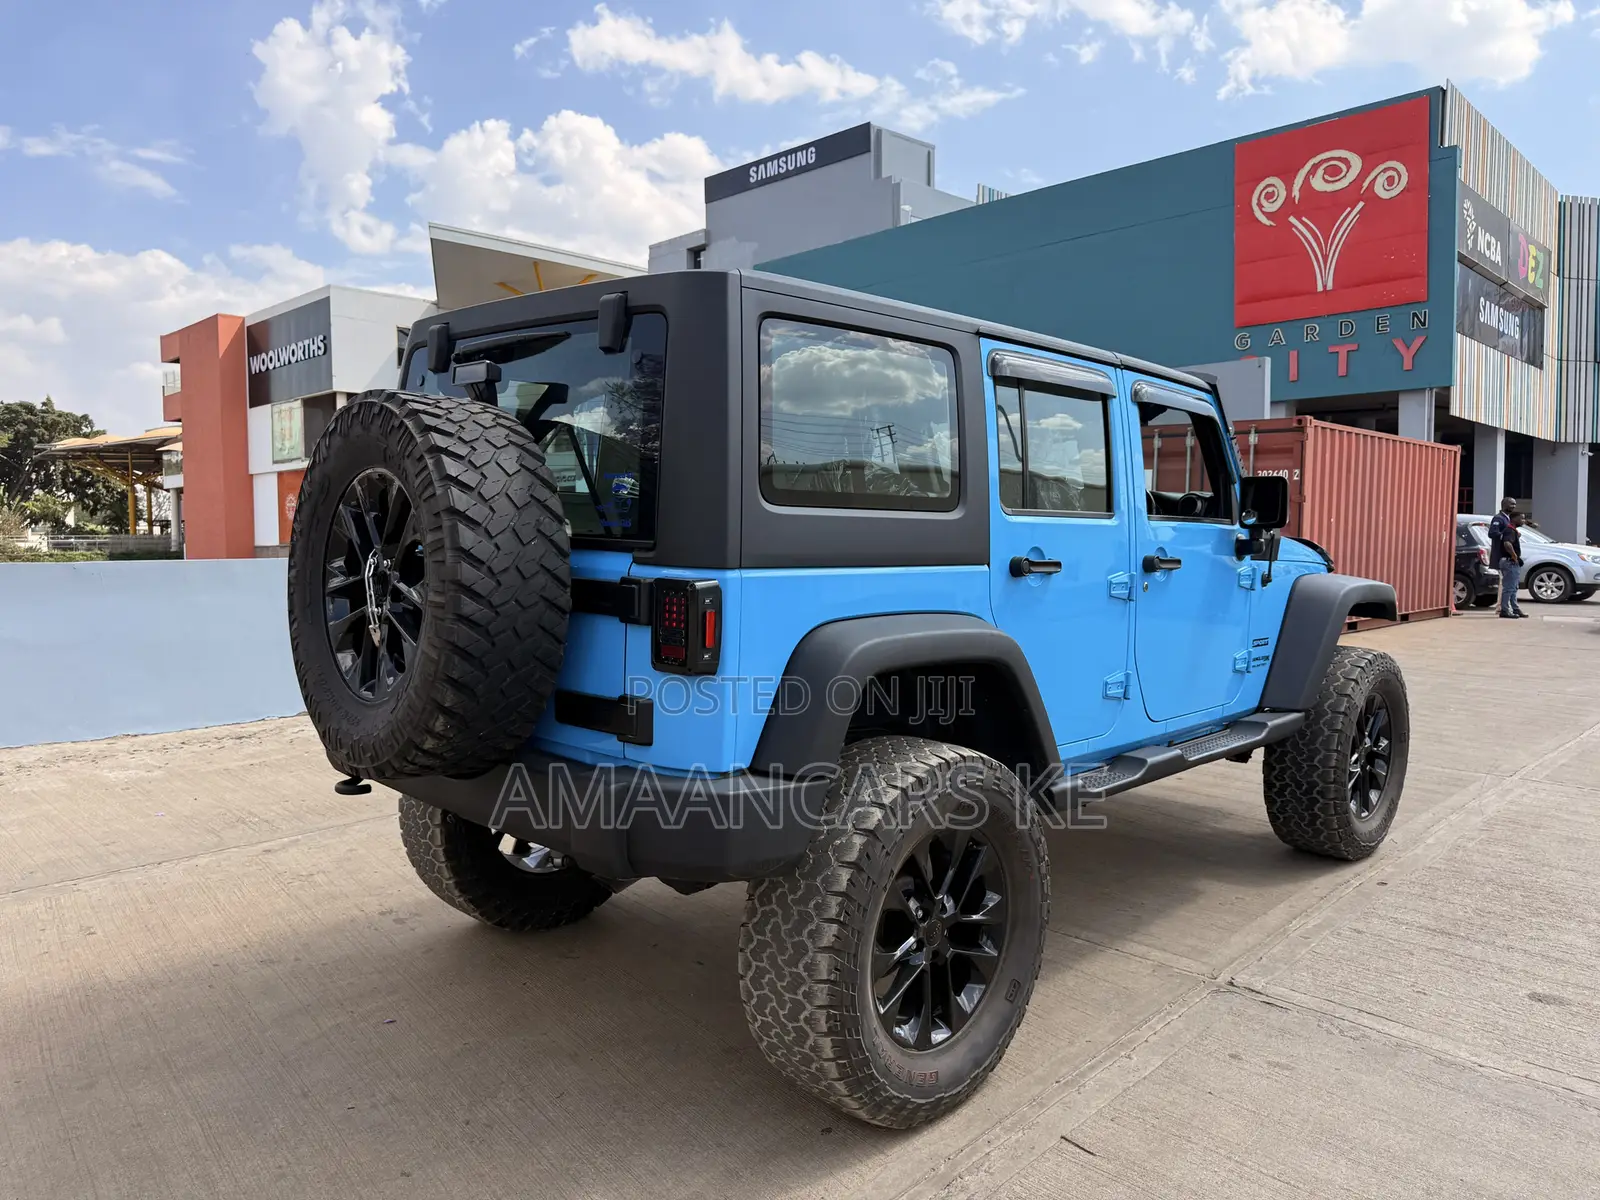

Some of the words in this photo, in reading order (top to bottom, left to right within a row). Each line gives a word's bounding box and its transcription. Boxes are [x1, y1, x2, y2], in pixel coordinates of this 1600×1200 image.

[749, 146, 816, 183] SAMSUNG
[1477, 226, 1502, 267] NCBA
[1234, 309, 1429, 350] GARDEN
[1478, 296, 1520, 340] SAMSUNG
[249, 334, 327, 375] WOOLWORTHS
[1240, 335, 1427, 382] ITY
[1293, 469, 1300, 480] 2
